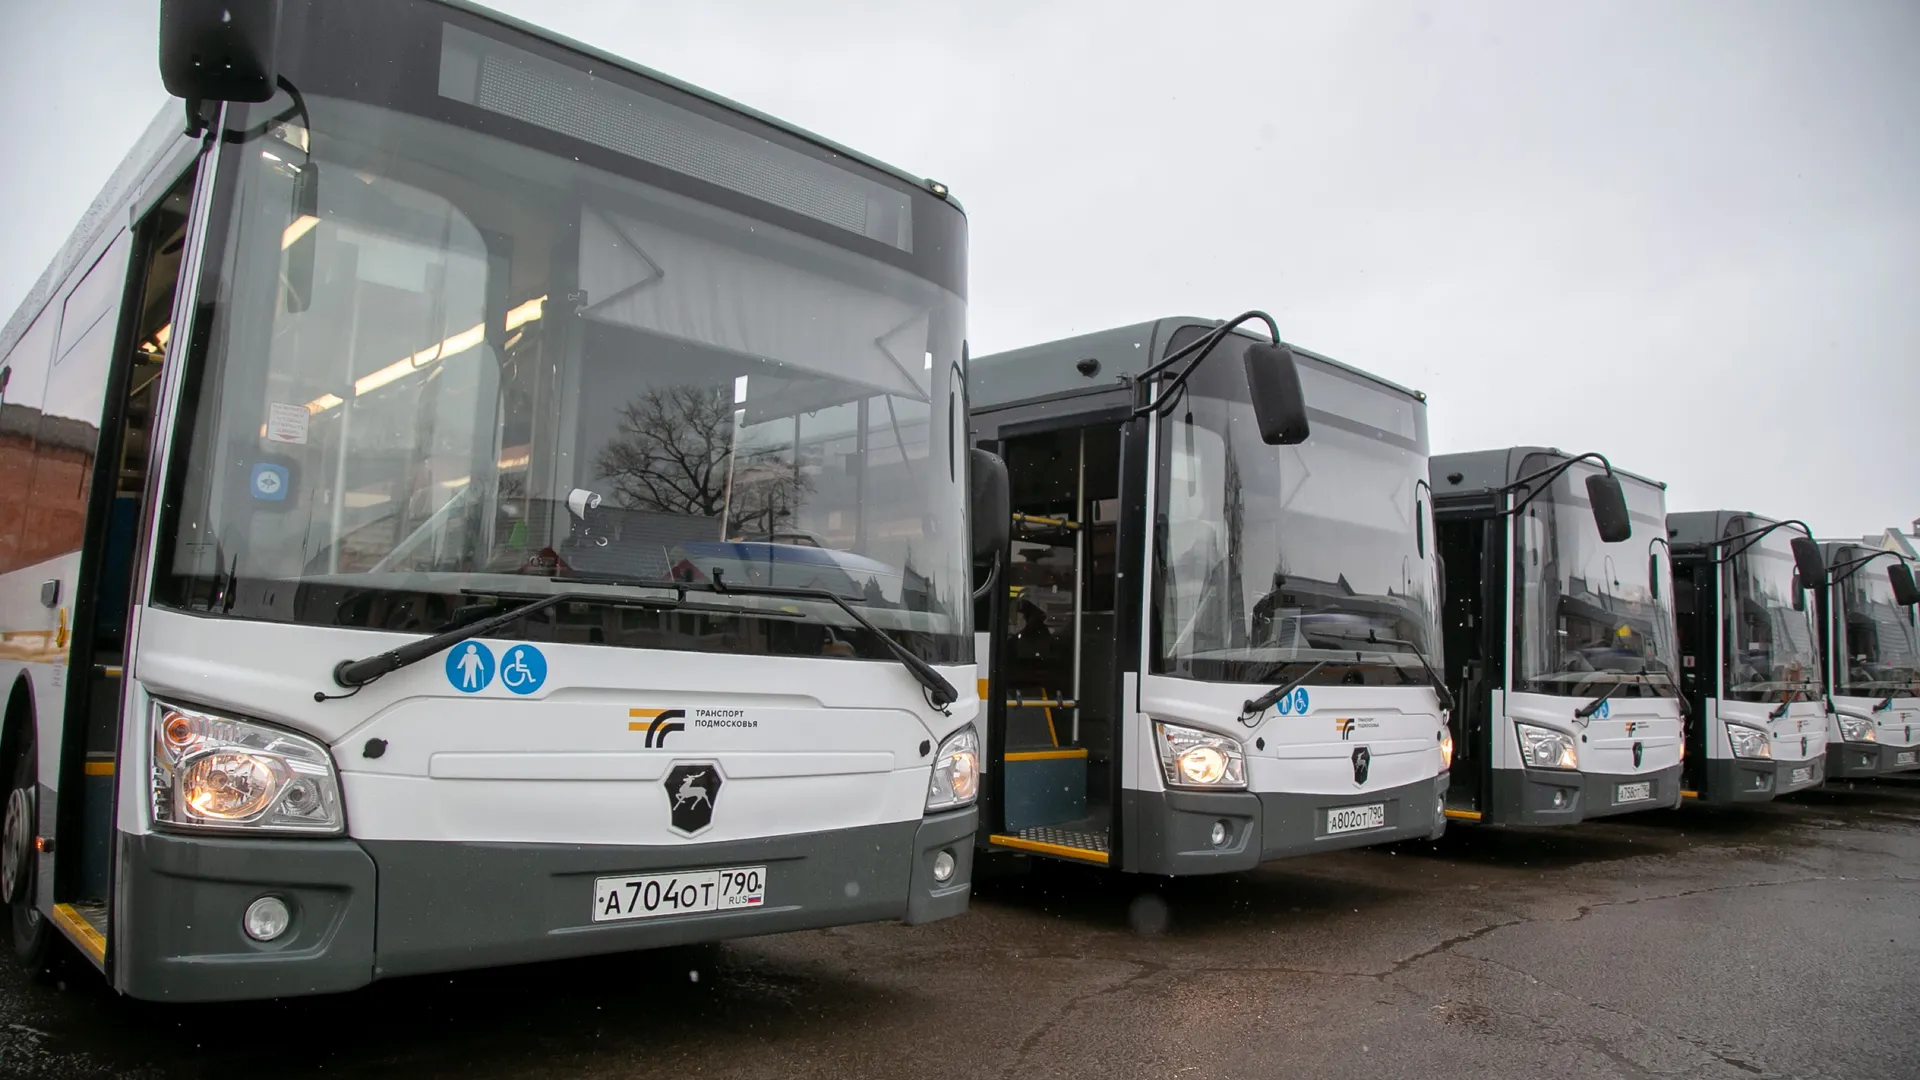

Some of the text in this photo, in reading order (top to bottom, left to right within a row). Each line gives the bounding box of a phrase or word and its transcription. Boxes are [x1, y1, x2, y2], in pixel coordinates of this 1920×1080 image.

[696, 709, 744, 718] ТРАНСПОРТ
[695, 719, 758, 728] ПОДМОСКОВЬЯ
[1331, 806, 1382, 830] А802ОТ 790
[604, 871, 759, 915] А704ОТ 790
[728, 894, 748, 905] RUS
